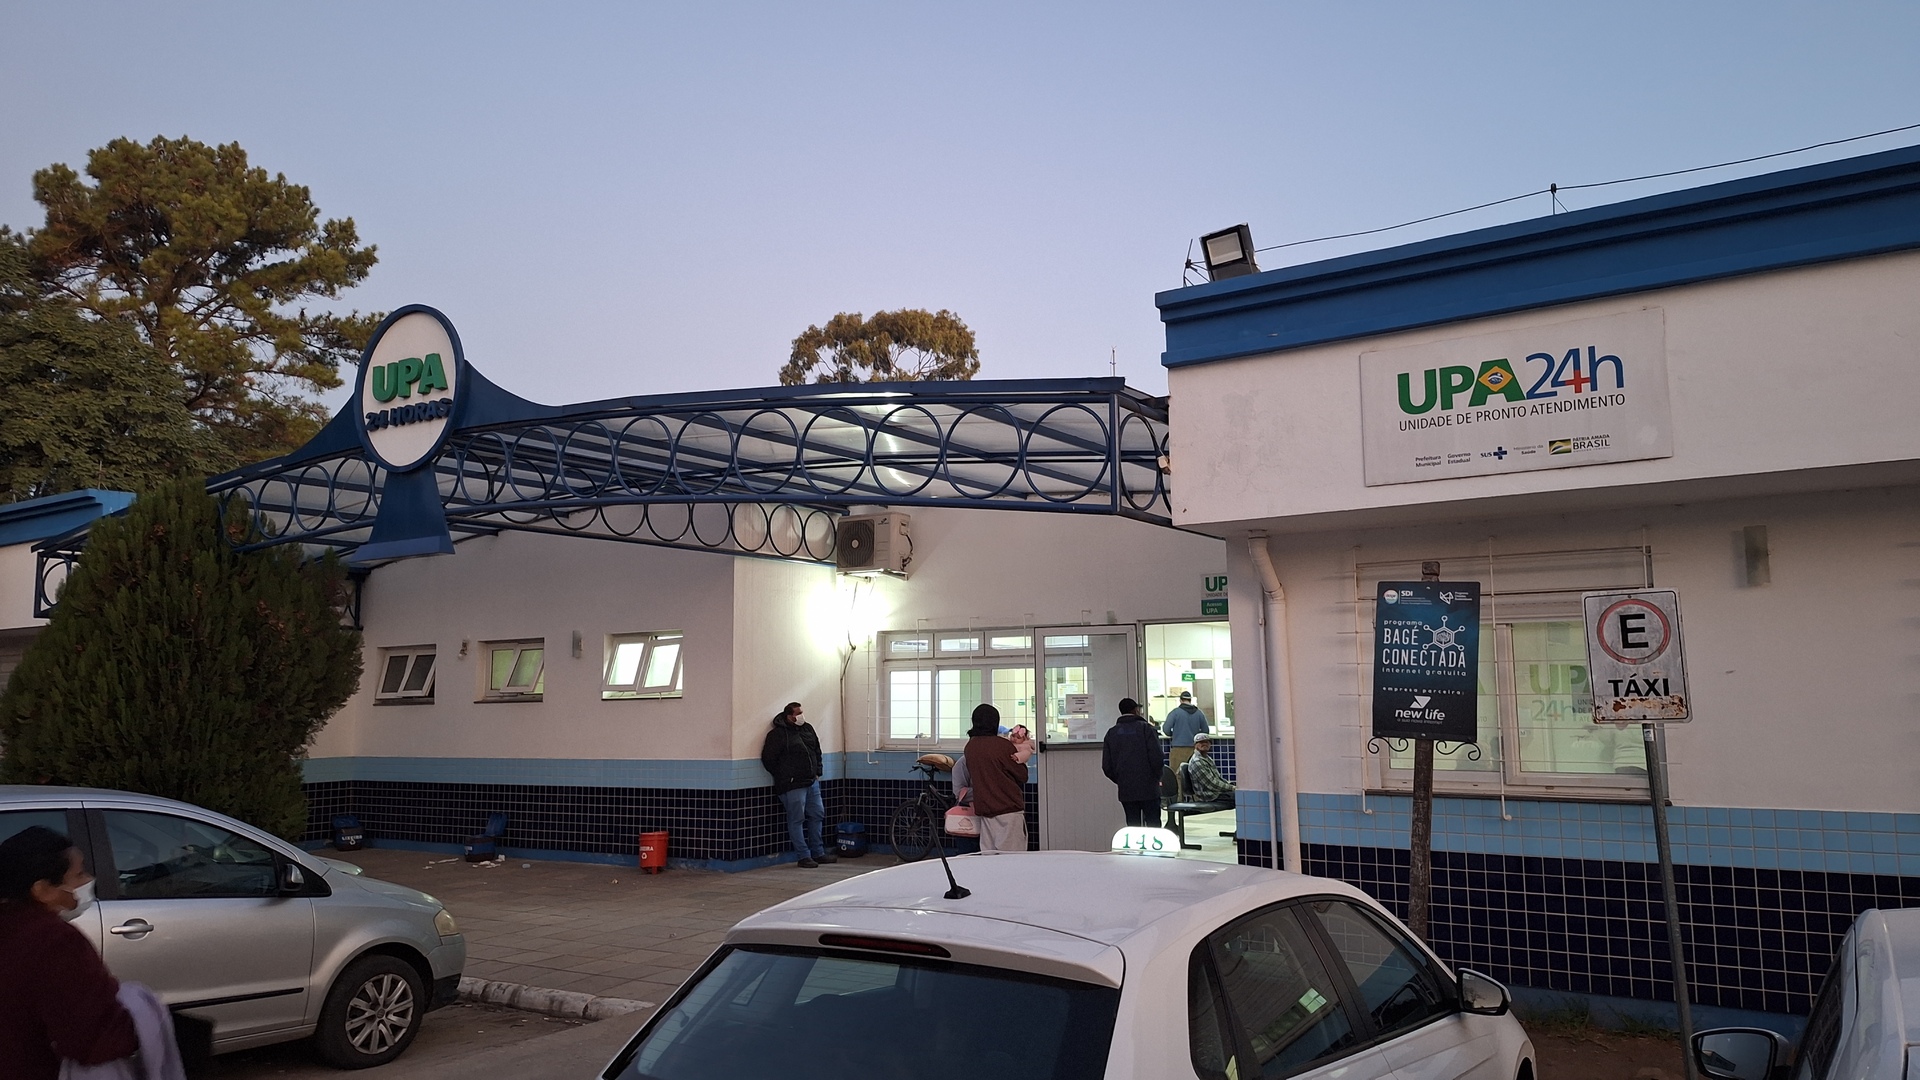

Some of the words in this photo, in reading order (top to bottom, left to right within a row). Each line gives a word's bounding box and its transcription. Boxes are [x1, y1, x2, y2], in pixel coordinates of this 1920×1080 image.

[373, 353, 448, 402] UPA
[365, 410, 389, 431] 24
[390, 398, 452, 426] HORAS
[1399, 415, 1452, 431] UNIDADE
[1456, 412, 1472, 424] DE
[1476, 405, 1526, 422] PRONTO
[1530, 393, 1625, 415] ATENDIMENTO
[1573, 439, 1610, 450] BRASIL
[1415, 460, 1441, 468] Municipal
[1447, 457, 1471, 465] Estadual
[1205, 576, 1228, 592] UP
[1383, 625, 1419, 645] BAGÉ
[1619, 613, 1649, 649] E
[1382, 648, 1466, 668] CONECTADA
[1608, 673, 1670, 698] TÁXI
[1395, 709, 1422, 719] new
[1424, 708, 1446, 721] life
[1122, 833, 1163, 851] 148
